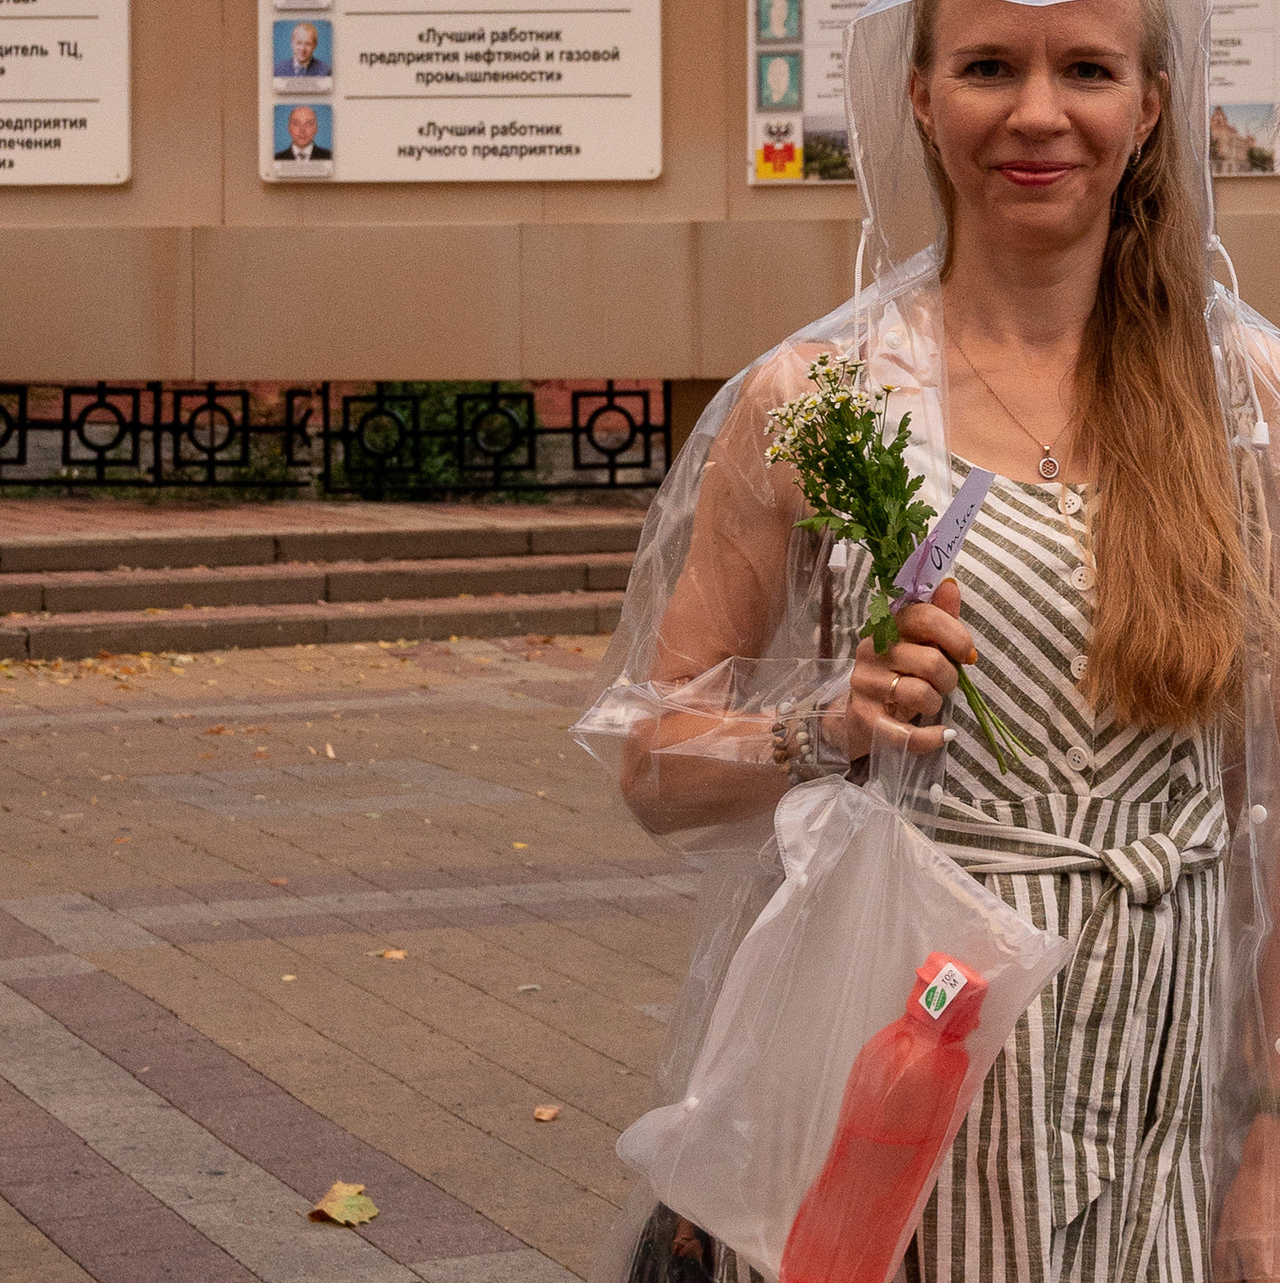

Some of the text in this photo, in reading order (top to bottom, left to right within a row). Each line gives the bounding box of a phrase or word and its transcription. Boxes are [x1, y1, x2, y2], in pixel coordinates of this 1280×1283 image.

[418, 27, 562, 46] «Лучший работник
[359, 46, 620, 68] предприятия нефтяной и газовой
[416, 70, 562, 86] промышленности»
[418, 120, 562, 140] «Лучший работник
[398, 143, 581, 161] научного предприятия»
